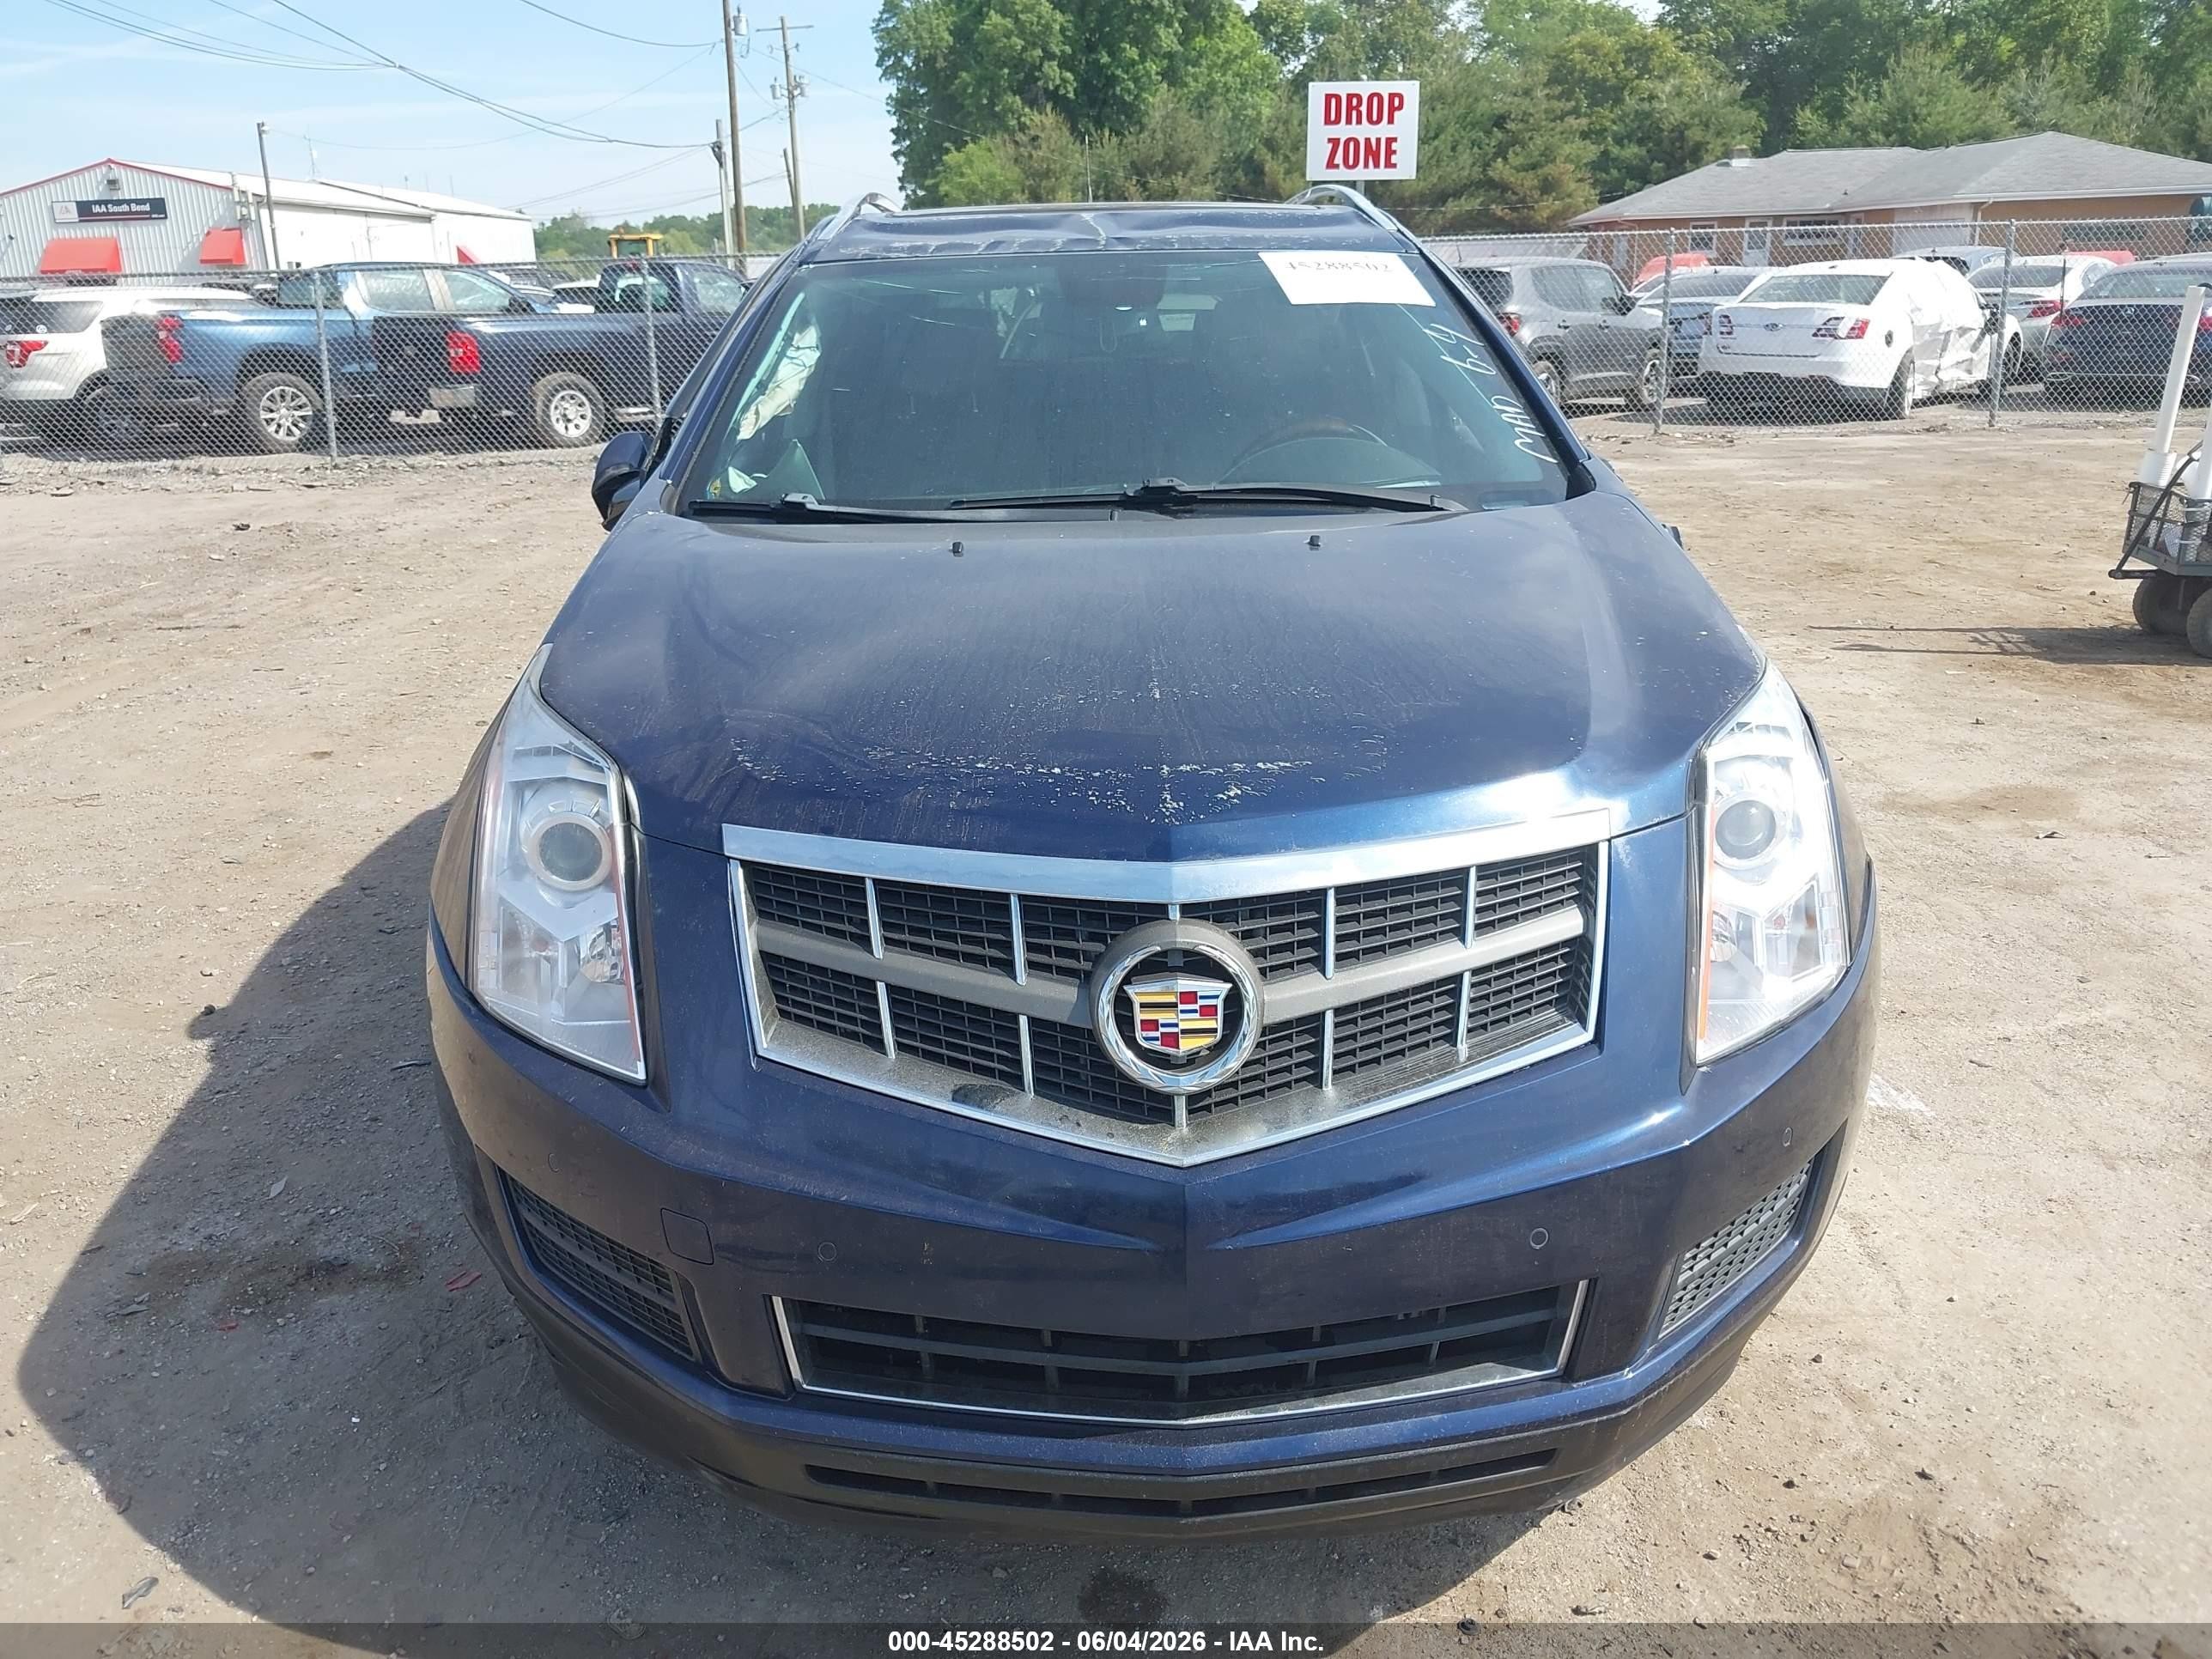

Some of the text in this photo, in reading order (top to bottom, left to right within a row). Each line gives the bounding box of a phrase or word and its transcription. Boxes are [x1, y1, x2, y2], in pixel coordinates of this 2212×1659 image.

[1323, 92, 1405, 125] DROP
[1326, 137, 1398, 170] ZONE
[92, 203, 150, 213] IAA South Bend
